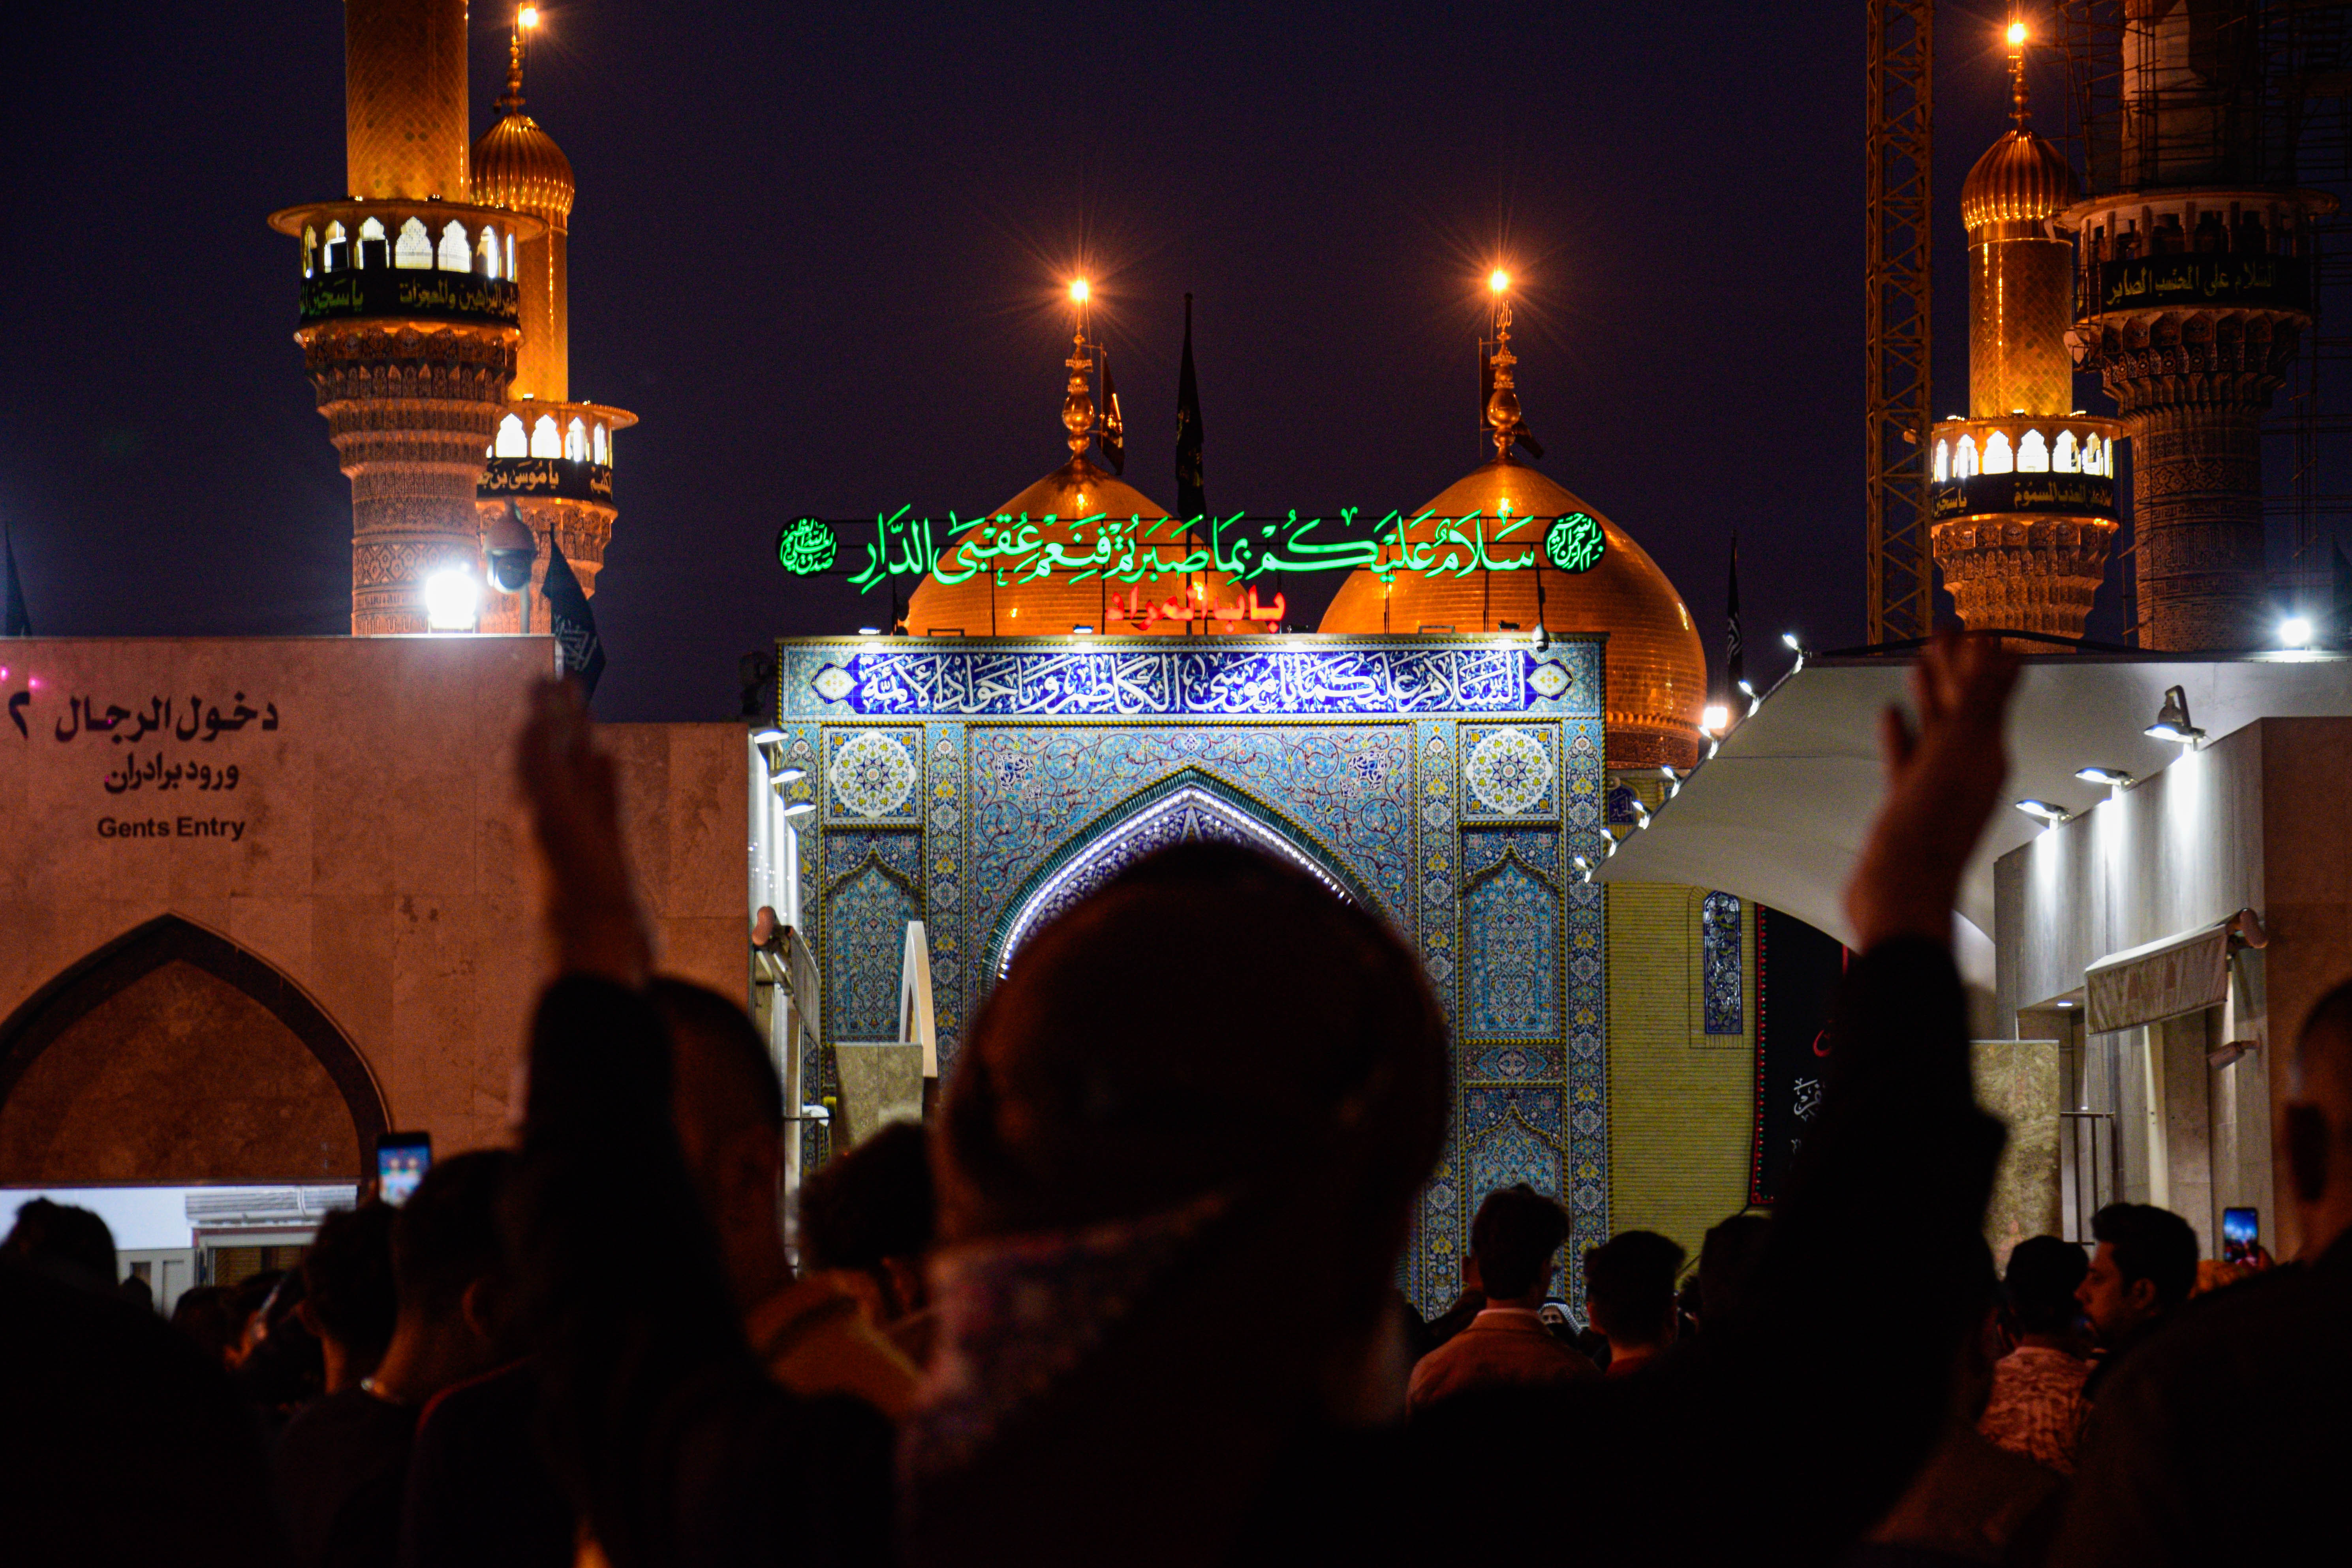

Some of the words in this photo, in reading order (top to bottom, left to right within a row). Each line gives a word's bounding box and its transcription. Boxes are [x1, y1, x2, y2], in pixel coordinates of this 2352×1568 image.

[2203, 261, 2230, 297] على
[55, 695, 171, 744] الرجال
[176, 691, 279, 742] دخول
[104, 751, 182, 794] برادران
[185, 760, 239, 791] ورود
[97, 817, 170, 838] Gents
[177, 817, 245, 841] Entry
